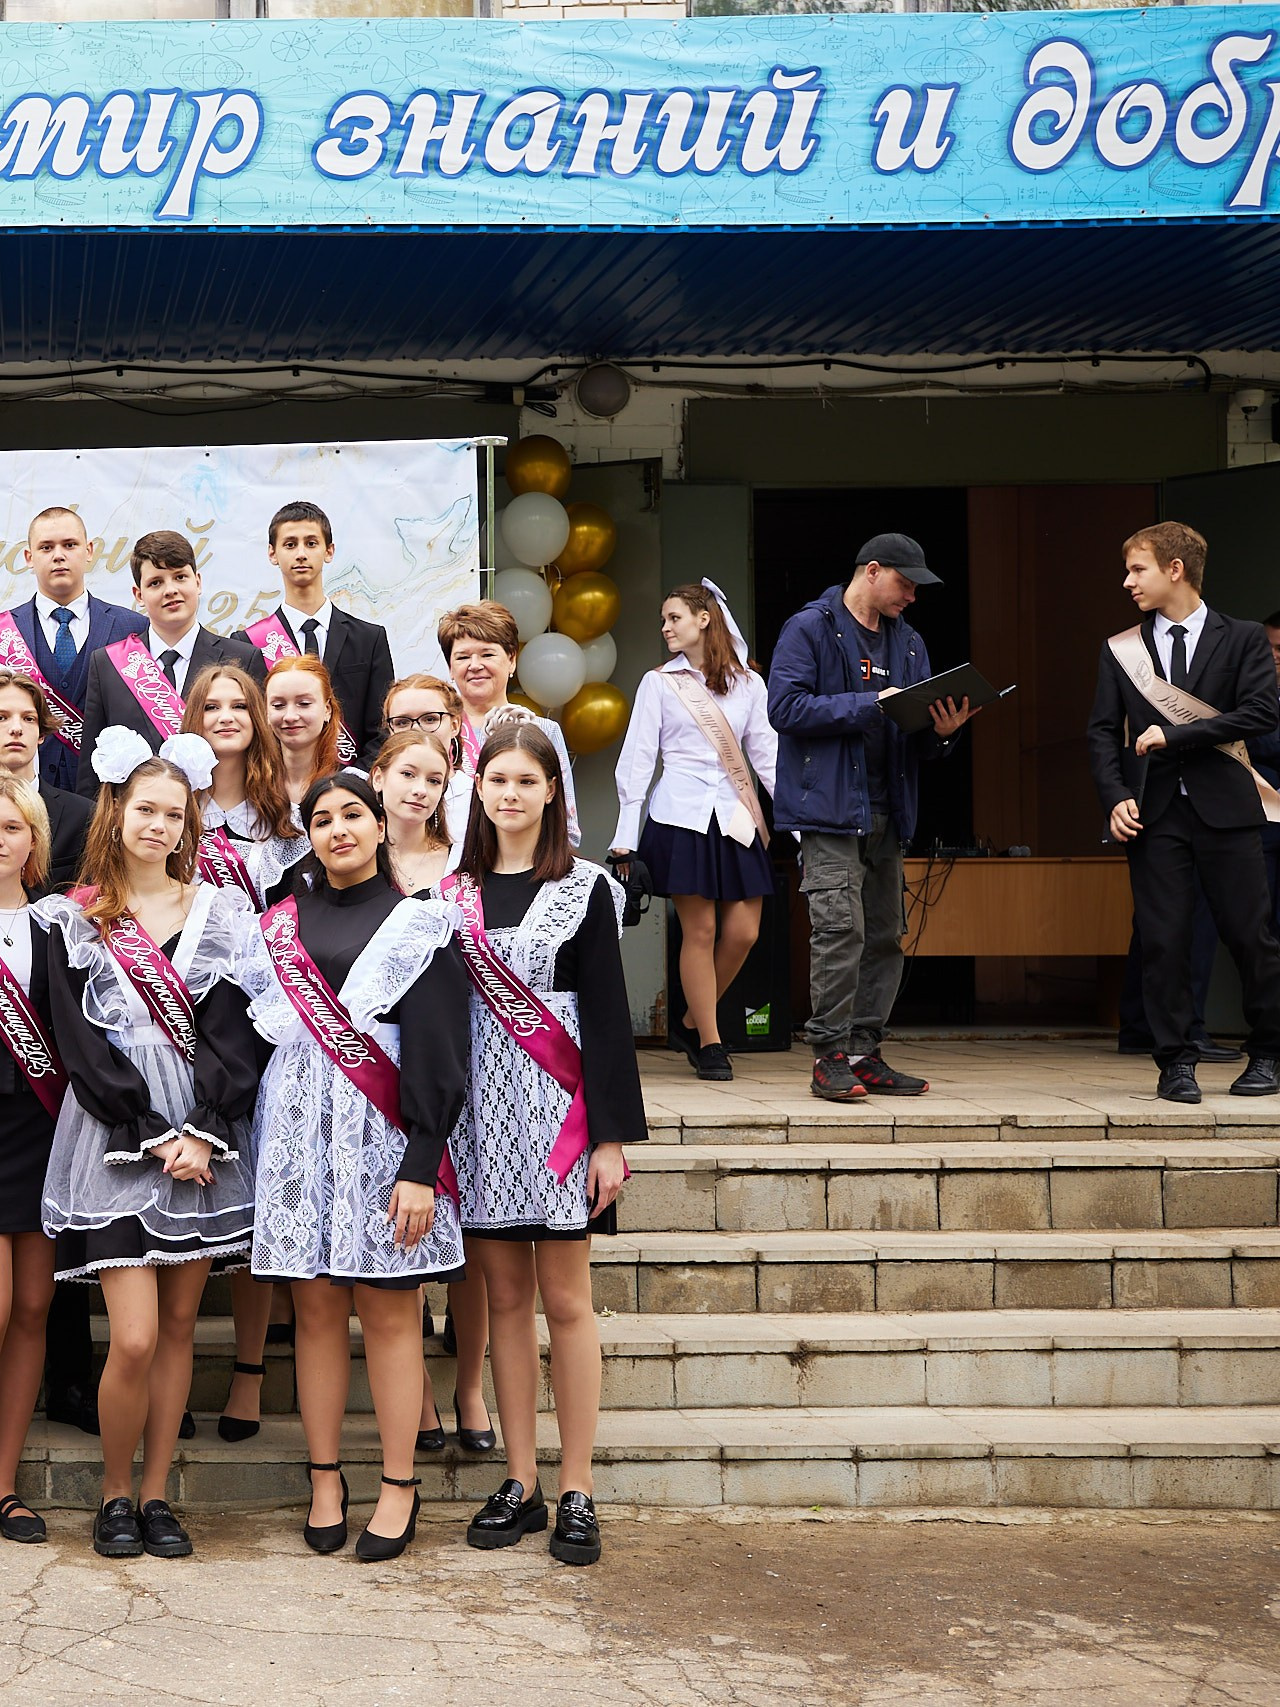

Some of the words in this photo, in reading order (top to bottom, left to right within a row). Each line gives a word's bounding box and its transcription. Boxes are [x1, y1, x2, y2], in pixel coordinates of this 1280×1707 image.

[312, 65, 827, 181] знаний
[867, 82, 962, 177] и
[270, 937, 344, 1034] Выпускница
[331, 1031, 377, 1069] 2025
[503, 999, 551, 1037] 2025
[20, 1042, 58, 1079] 2025
